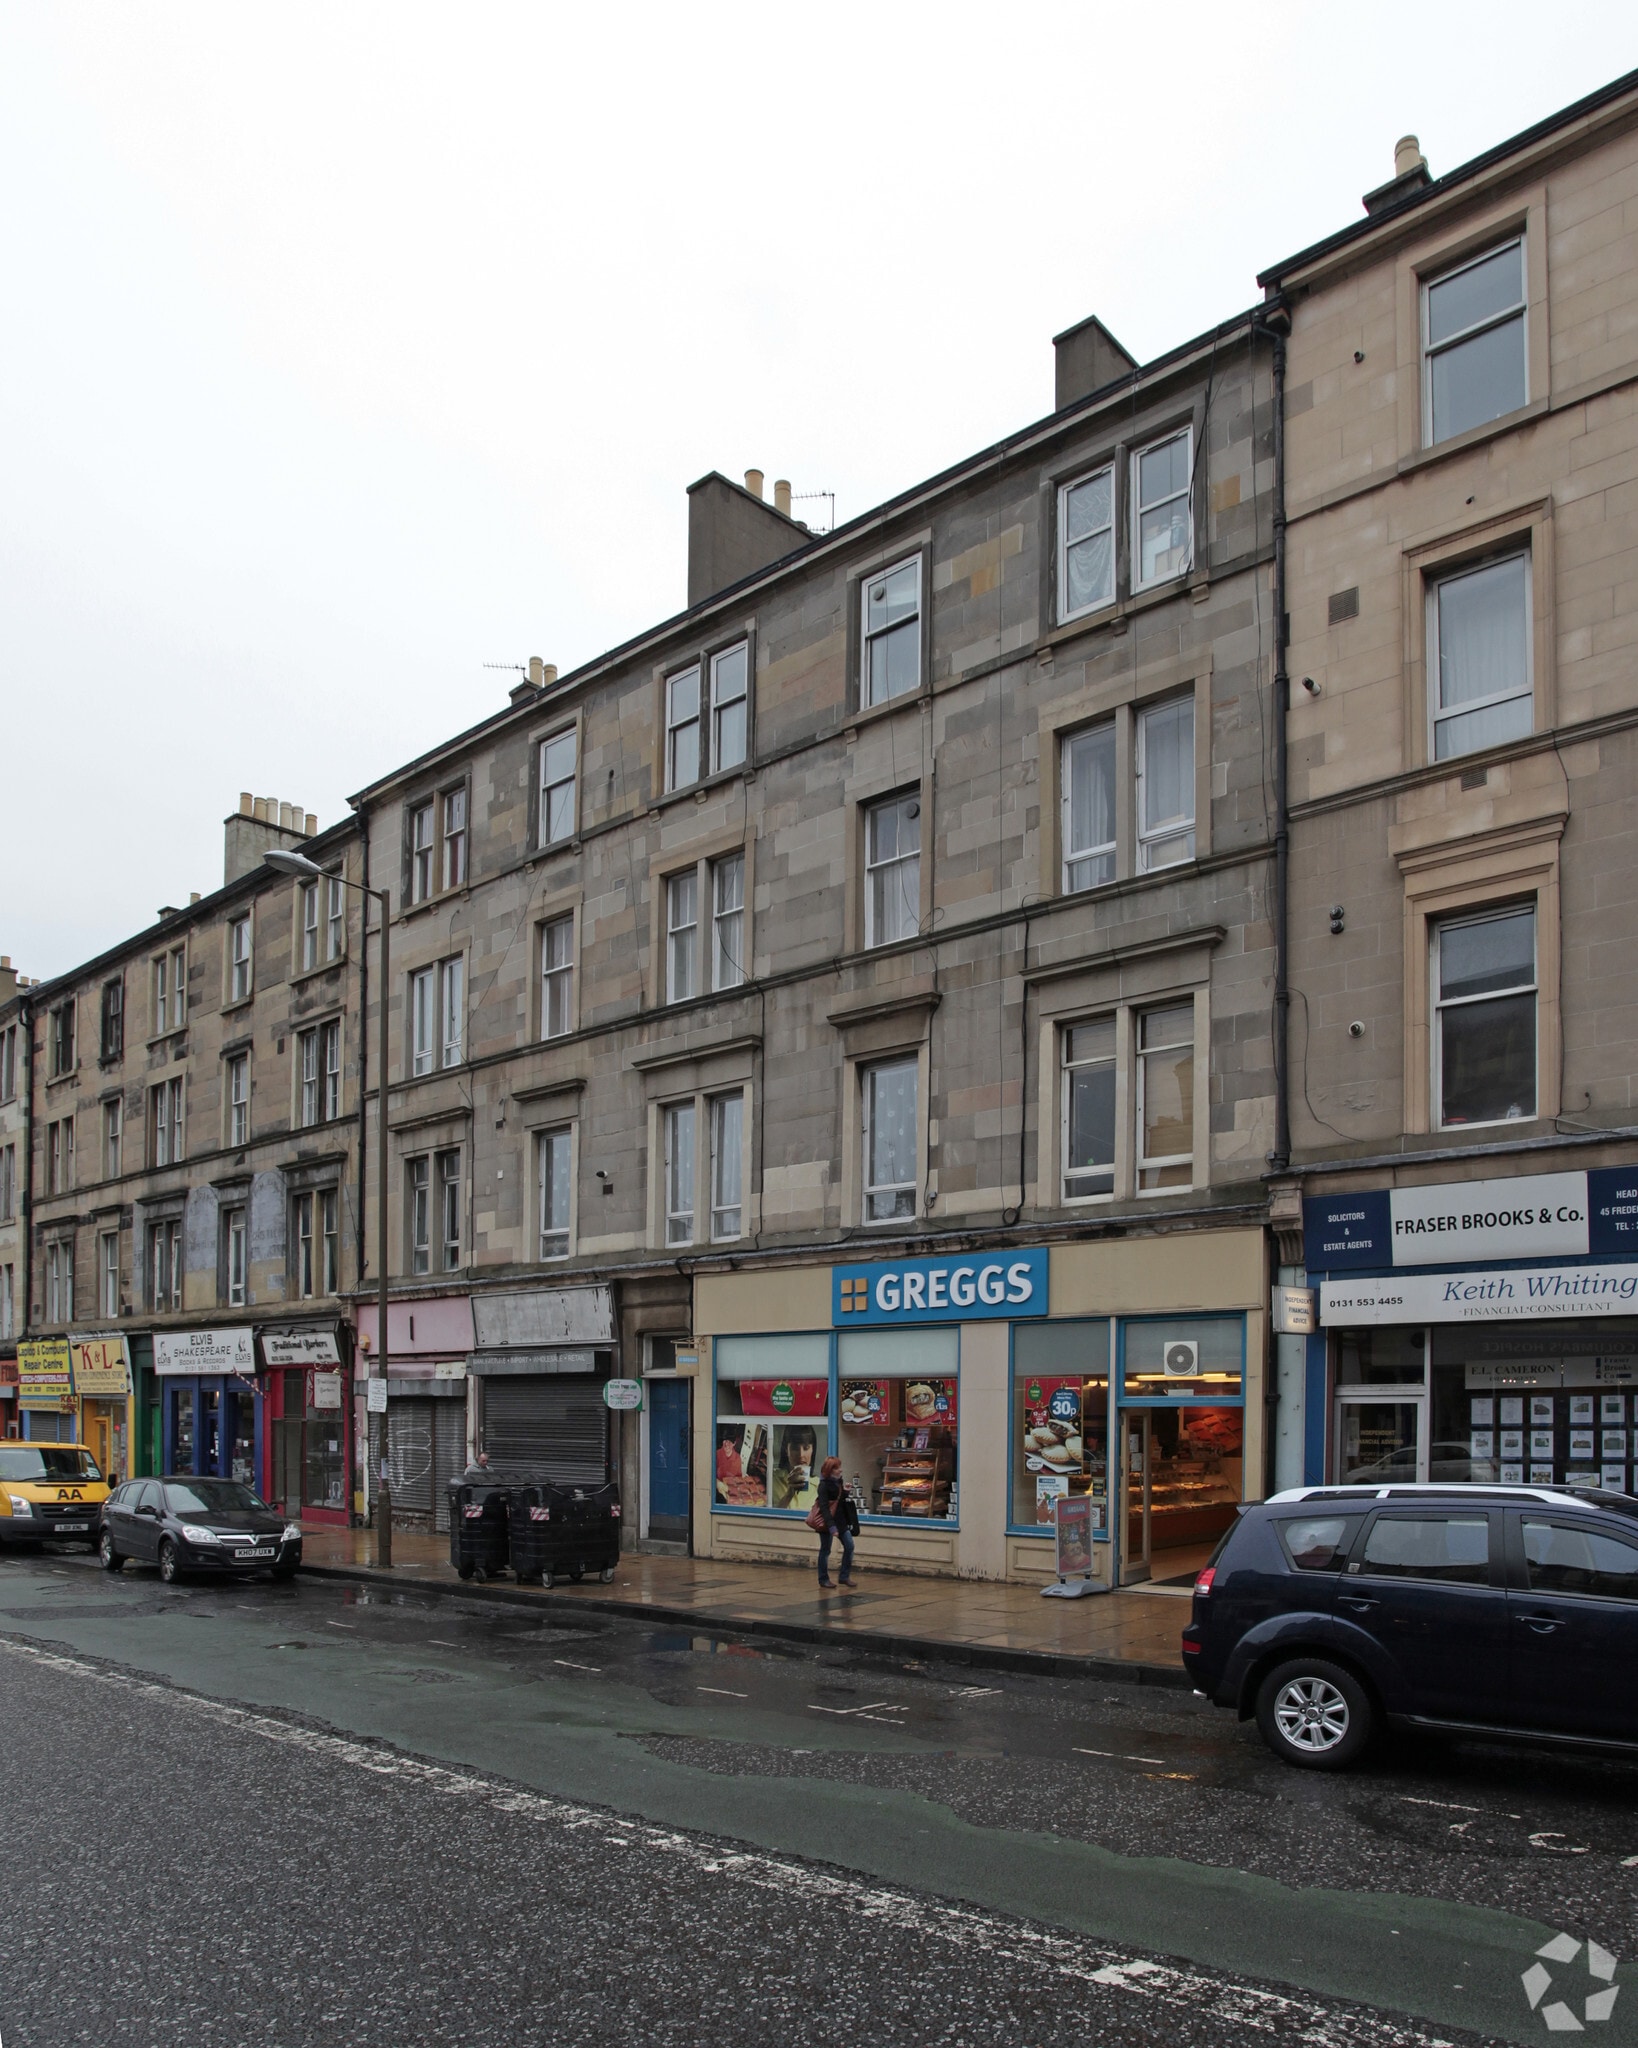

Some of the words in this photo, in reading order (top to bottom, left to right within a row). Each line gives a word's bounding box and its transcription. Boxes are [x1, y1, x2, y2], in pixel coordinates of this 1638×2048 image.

[1616, 1189, 1638, 1199] HEAD
[1327, 1211, 1365, 1223] SOLICITORS
[1600, 1208, 1610, 1216] 45
[1395, 1216, 1457, 1235] FRASER
[1462, 1209, 1534, 1229] BROOKS
[1538, 1208, 1552, 1224] &
[1556, 1206, 1584, 1222] Co.
[1344, 1228, 1350, 1236] &
[1615, 1223, 1630, 1231] TEL
[1323, 1242, 1346, 1251] ESTATE
[1347, 1240, 1373, 1250] AGENTS
[875, 1262, 1033, 1311] GREGGS
[1442, 1279, 1515, 1301] Keith
[1526, 1272, 1638, 1301] Whiting
[1285, 1296, 1312, 1304] INDEPENDENT
[1329, 1299, 1353, 1308] 0131
[1356, 1298, 1375, 1307] 553
[1378, 1296, 1403, 1305] 4455
[1289, 1307, 1310, 1315] FINANCIAL
[1463, 1306, 1527, 1316] FINANCIAL
[1529, 1302, 1613, 1313] CONSULTANT
[190, 1334, 212, 1345] ELVIS
[18, 1346, 35, 1357] Laptop
[41, 1344, 67, 1357] Computer
[173, 1345, 231, 1357] SHAKESPEARE
[271, 1340, 302, 1352] Traditional
[303, 1339, 328, 1351] Barbers
[80, 1344, 93, 1370] K
[94, 1351, 100, 1363] &
[102, 1343, 113, 1369] L
[157, 1356, 171, 1364] ELVIS
[179, 1358, 195, 1366] BOOKS
[24, 1360, 41, 1371] Repair
[43, 1359, 63, 1369] Centre
[1471, 1367, 1492, 1375] E.L.
[1495, 1364, 1555, 1375] CAMERON
[1052, 1400, 1077, 1416] 30p
[57, 1488, 83, 1500] AA
[1067, 1504, 1086, 1513] GREGGS
[238, 1549, 257, 1557] KH07
